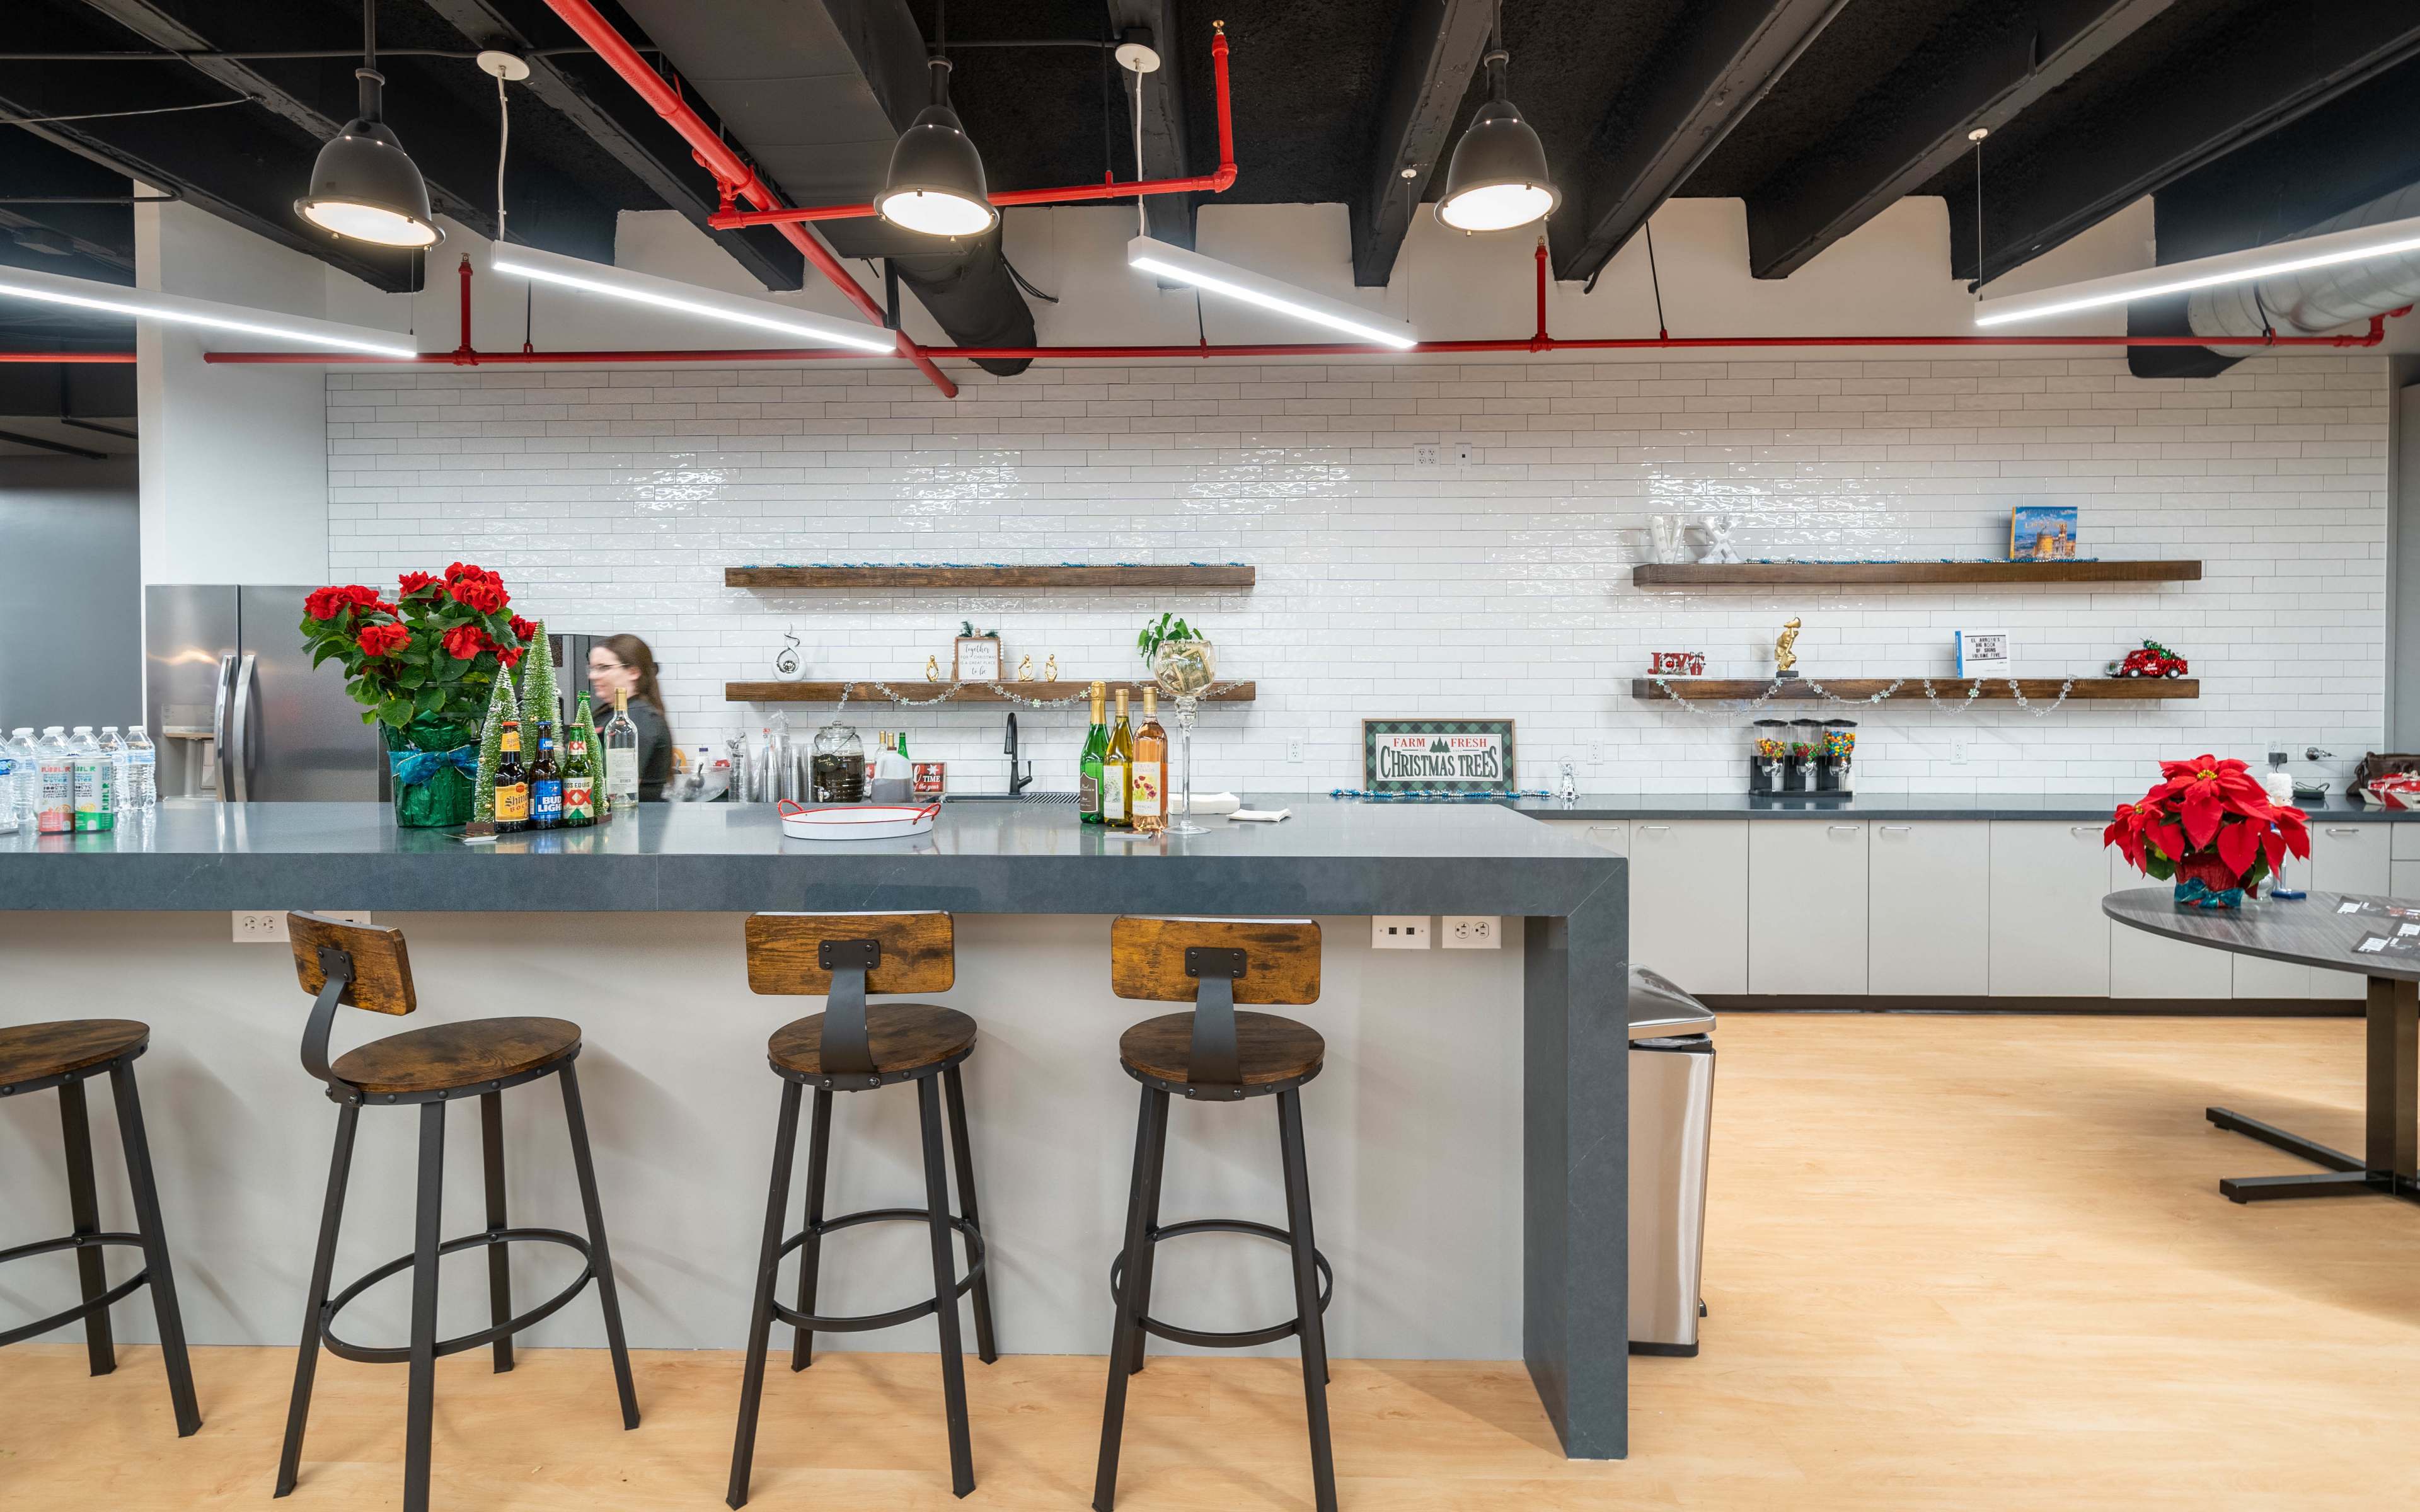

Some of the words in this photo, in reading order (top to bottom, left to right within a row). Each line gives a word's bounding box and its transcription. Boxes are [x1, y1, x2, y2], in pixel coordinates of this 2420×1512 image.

[964, 643, 989, 658] Together
[979, 665, 987, 676] be
[1393, 738, 1426, 747] FARM
[1451, 738, 1487, 747] FRESH
[1380, 745, 1455, 779] CHRISTMAS
[1458, 745, 1499, 779] TREES
[542, 796, 562, 804] BUD
[563, 789, 592, 806] XX
[538, 803, 562, 812] LIGH
